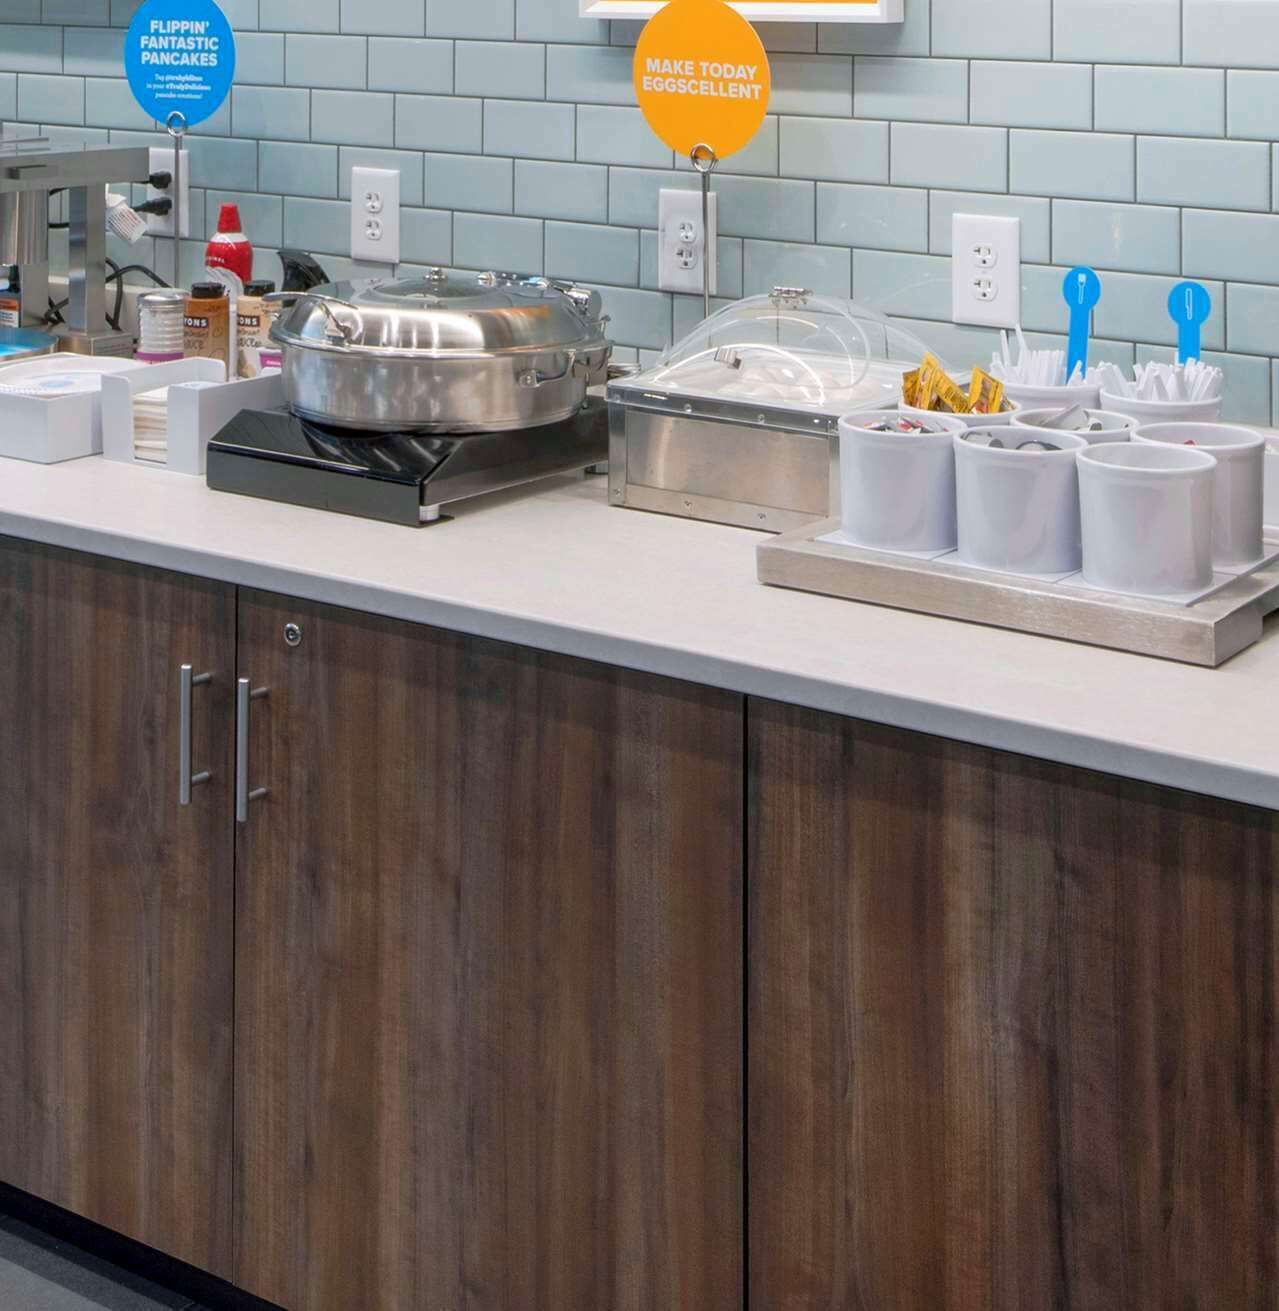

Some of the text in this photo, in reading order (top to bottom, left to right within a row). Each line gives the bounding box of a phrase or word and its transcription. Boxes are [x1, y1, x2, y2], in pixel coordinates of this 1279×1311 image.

[150, 20, 210, 34] FLIPPIN'
[140, 35, 219, 50] FANTASTIC
[141, 51, 218, 66] PANCAKES
[646, 57, 757, 80] MAKE TODAY
[642, 76, 762, 100] EGGSCELLENT
[184, 318, 207, 327] YONS
